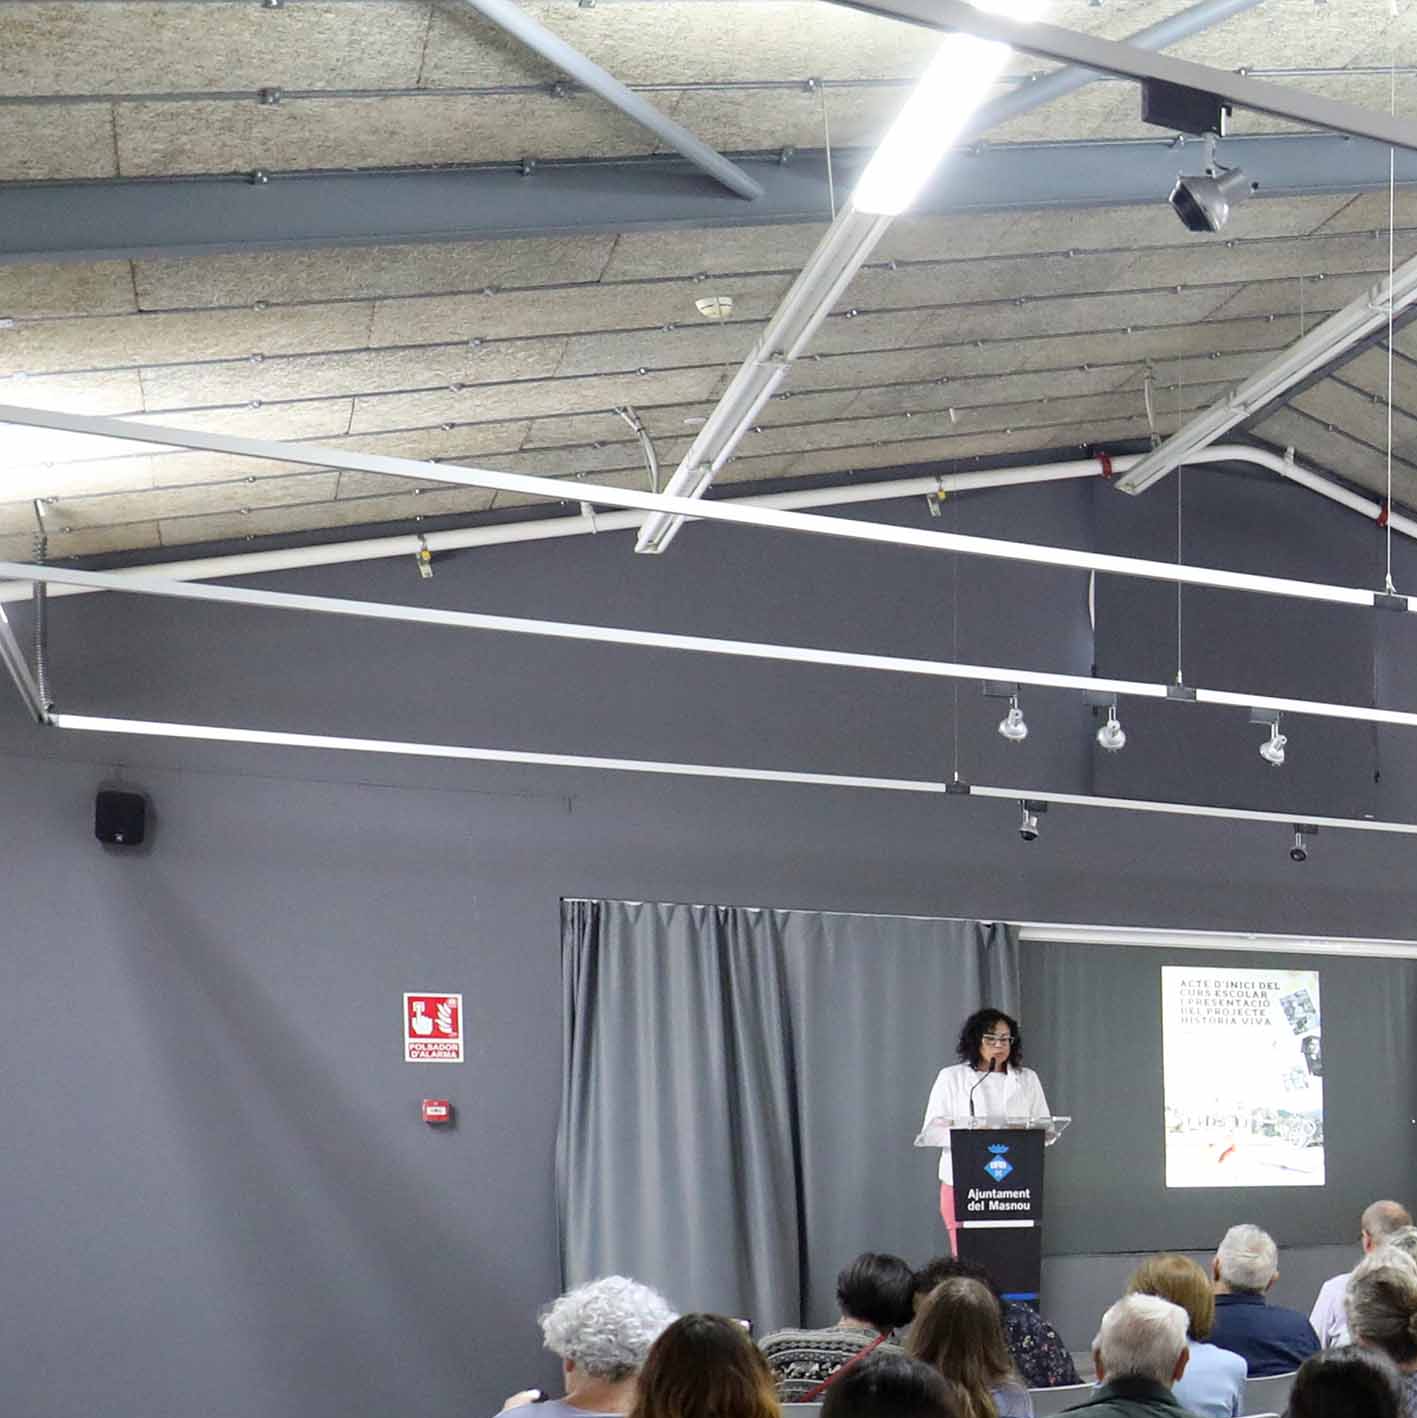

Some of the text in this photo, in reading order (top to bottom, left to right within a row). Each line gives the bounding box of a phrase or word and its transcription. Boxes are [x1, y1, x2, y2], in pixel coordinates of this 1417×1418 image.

[1180, 980, 1280, 990] ACTE D'INICI DEL
[1180, 989, 1268, 998] CURS ESCOLAR
[1206, 1008, 1266, 1016] PROJECTE
[1241, 1017, 1271, 1025] VIVA
[968, 1188, 1030, 1200] Ajuntament
[968, 1201, 1030, 1211] del Masnou
